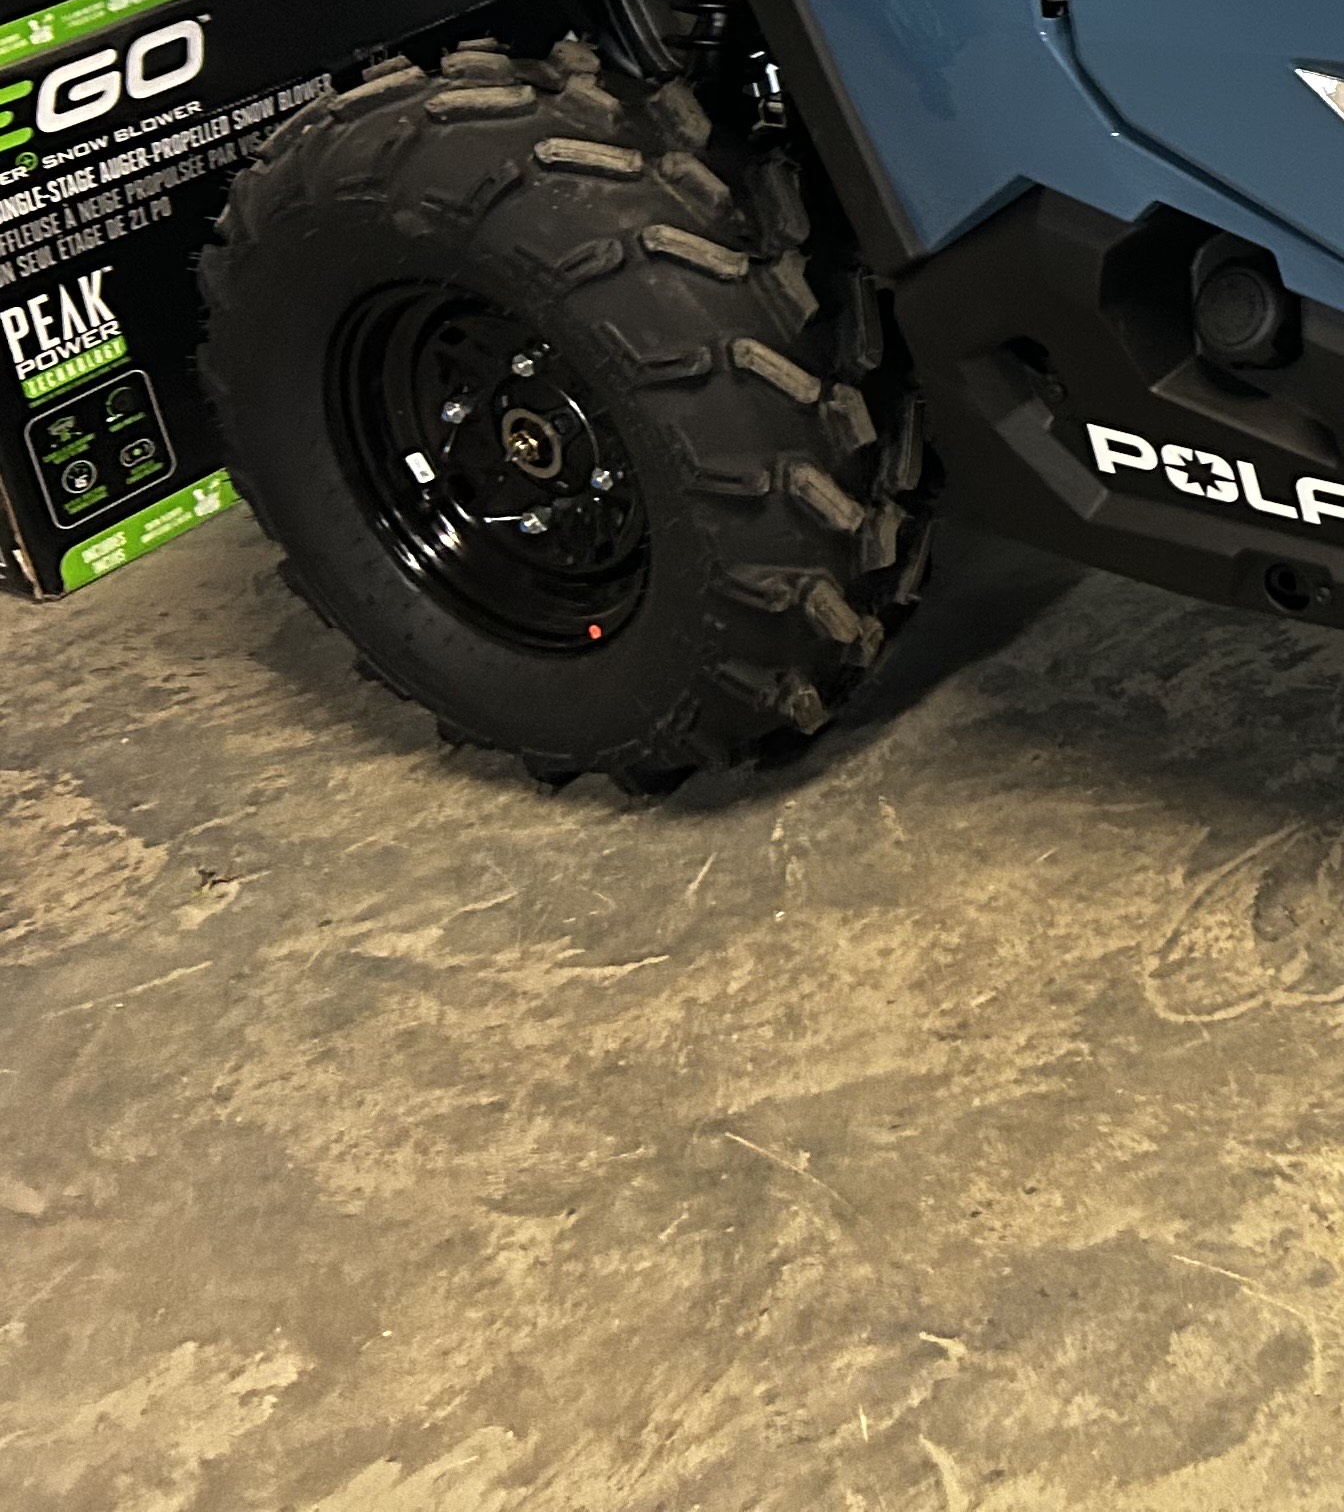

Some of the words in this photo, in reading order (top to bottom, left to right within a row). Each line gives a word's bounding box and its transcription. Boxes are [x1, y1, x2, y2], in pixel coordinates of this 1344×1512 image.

[42, 135, 109, 170] SNOW
[113, 100, 203, 143] BLOWER
[231, 95, 275, 131] SNOW
[0, 268, 117, 364] PEAK
[15, 320, 122, 381] POWER
